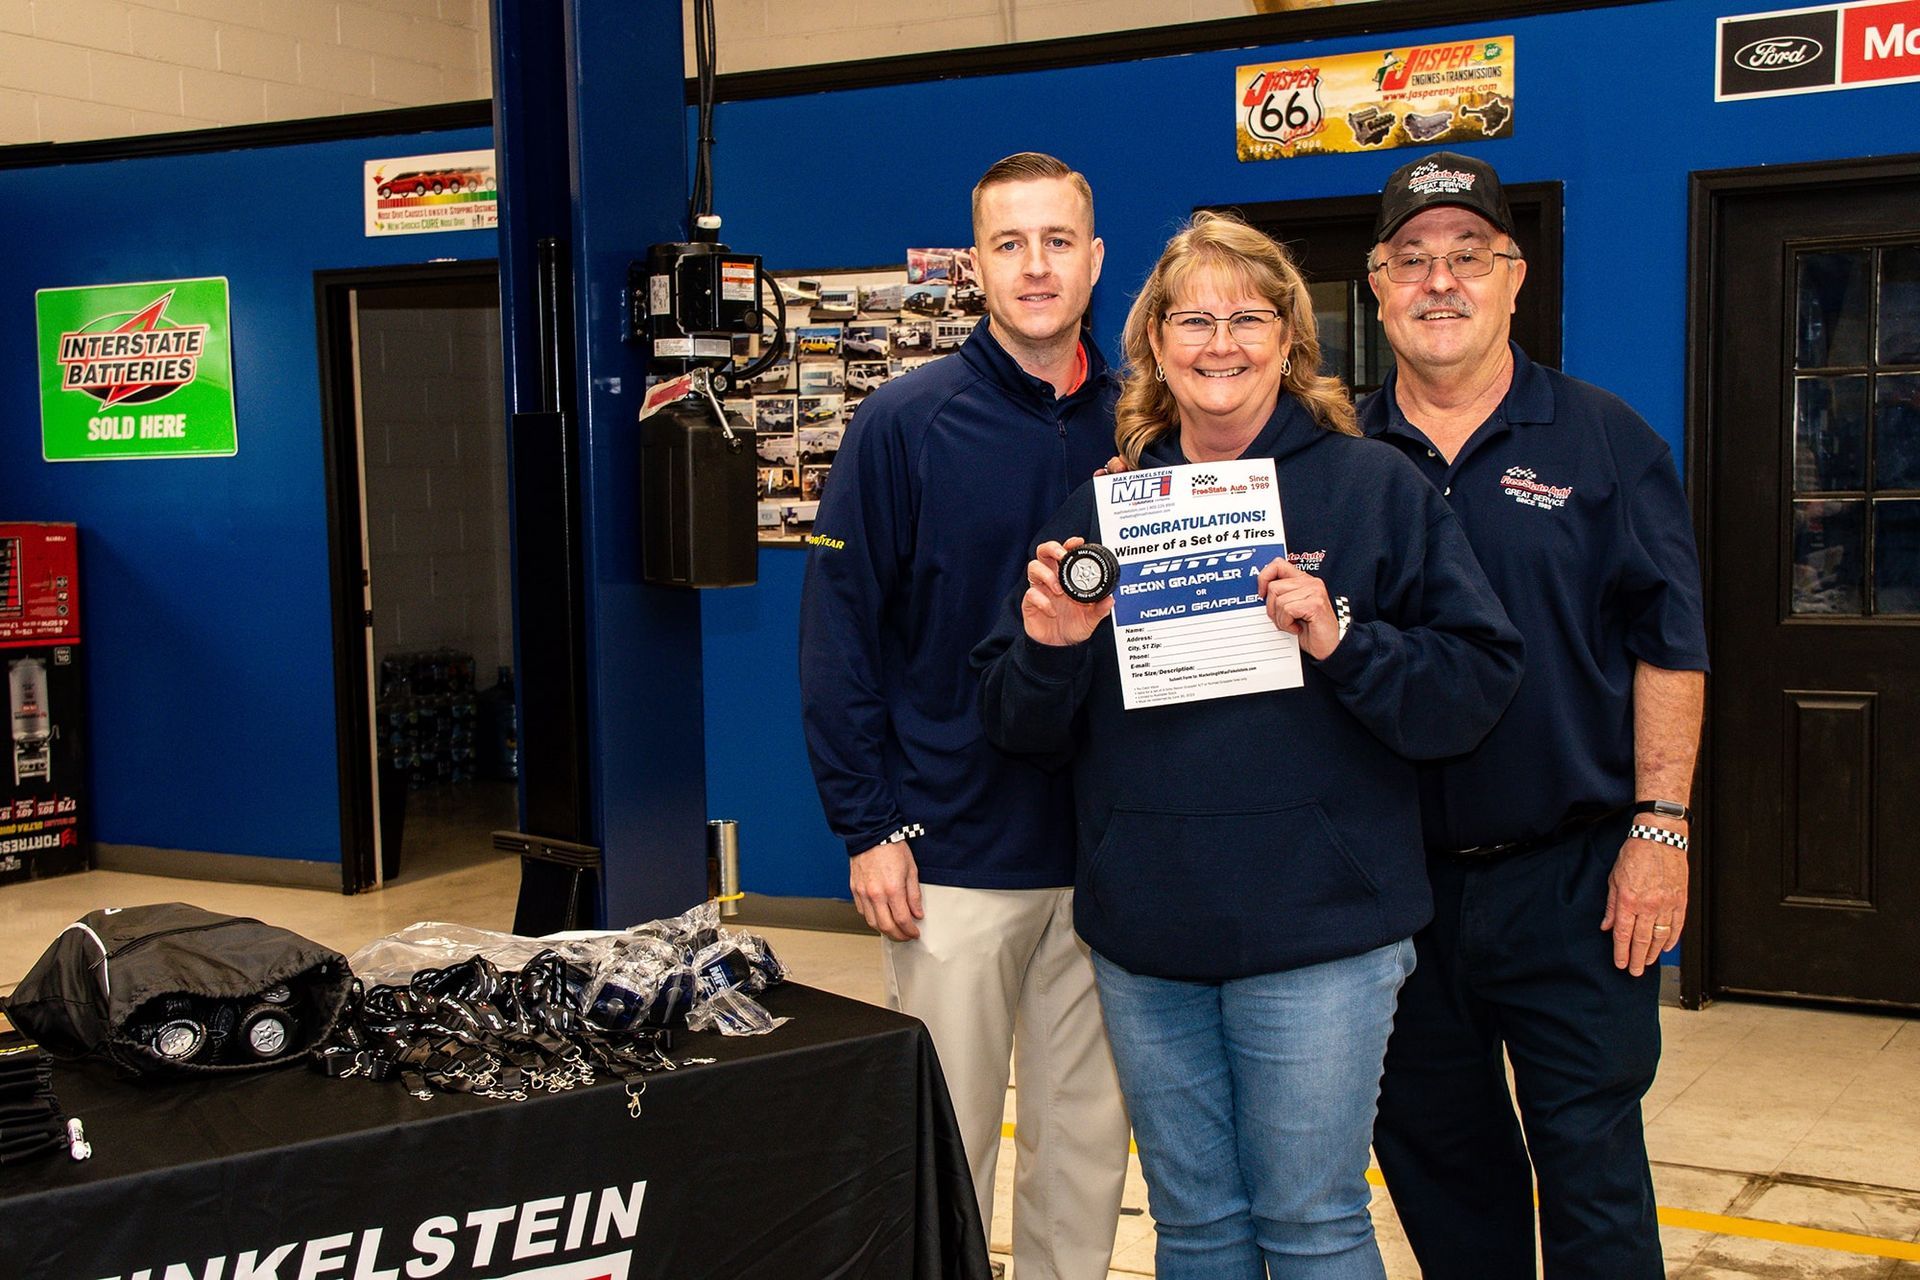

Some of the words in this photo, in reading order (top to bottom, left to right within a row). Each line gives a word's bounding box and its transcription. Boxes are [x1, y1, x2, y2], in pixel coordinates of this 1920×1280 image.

[1863, 22, 1920, 61] Mo
[1750, 40, 1807, 67] Ford
[1381, 44, 1476, 91] JASPER
[1411, 72, 1441, 87] ENGINES
[1445, 66, 1503, 83] TRANSMISSIONS
[1243, 68, 1320, 107] JASPER
[1382, 83, 1498, 101] www.jasperengines.com
[1260, 91, 1309, 132] 66
[1249, 143, 1275, 153] 1942
[1413, 181, 1438, 193] GREAT
[1438, 180, 1472, 191] SERVICE
[63, 331, 200, 358] INTERSTATE
[68, 357, 192, 385] BATTERIES
[87, 415, 136, 441] SOLD
[139, 413, 187, 440] HERE
[1112, 475, 1128, 483] MAX
[1128, 470, 1173, 480] FINKELSTEIN
[1248, 474, 1270, 483] Since
[1191, 486, 1228, 496] FreeState
[1230, 484, 1248, 492] Auto
[1250, 482, 1270, 491] 1989
[1504, 487, 1533, 499] GREAT
[1532, 493, 1565, 507] SERVICE
[1515, 497, 1537, 506] SINCE
[1119, 509, 1267, 540] CONGRATULATIONS!
[1115, 543, 1159, 558] Winner
[1162, 538, 1177, 551] of
[1179, 540, 1187, 548] a
[1190, 533, 1212, 546] Set
[1215, 530, 1229, 543] of
[1232, 529, 1240, 541] 4
[1243, 527, 1275, 540] Tires
[1295, 562, 1321, 571] RVICE
[1119, 579, 1166, 596] RECON
[1168, 567, 1242, 589] GRAPPLER
[1195, 588, 1207, 596] OR
[1139, 603, 1186, 619] NOMAD
[1190, 593, 1264, 612] GRAPPLER
[1125, 626, 1145, 635] Name:
[1126, 634, 1153, 643] Address:
[1150, 642, 1162, 650] Zip:
[1129, 653, 1150, 661] Phone:
[1130, 662, 1151, 670] E-mail:
[1131, 671, 1143, 679] Tire
[1144, 665, 1195, 678] Size/Description:
[0, 833, 61, 855] FORTRES
[98, 1180, 648, 1280] KELSTEIN
